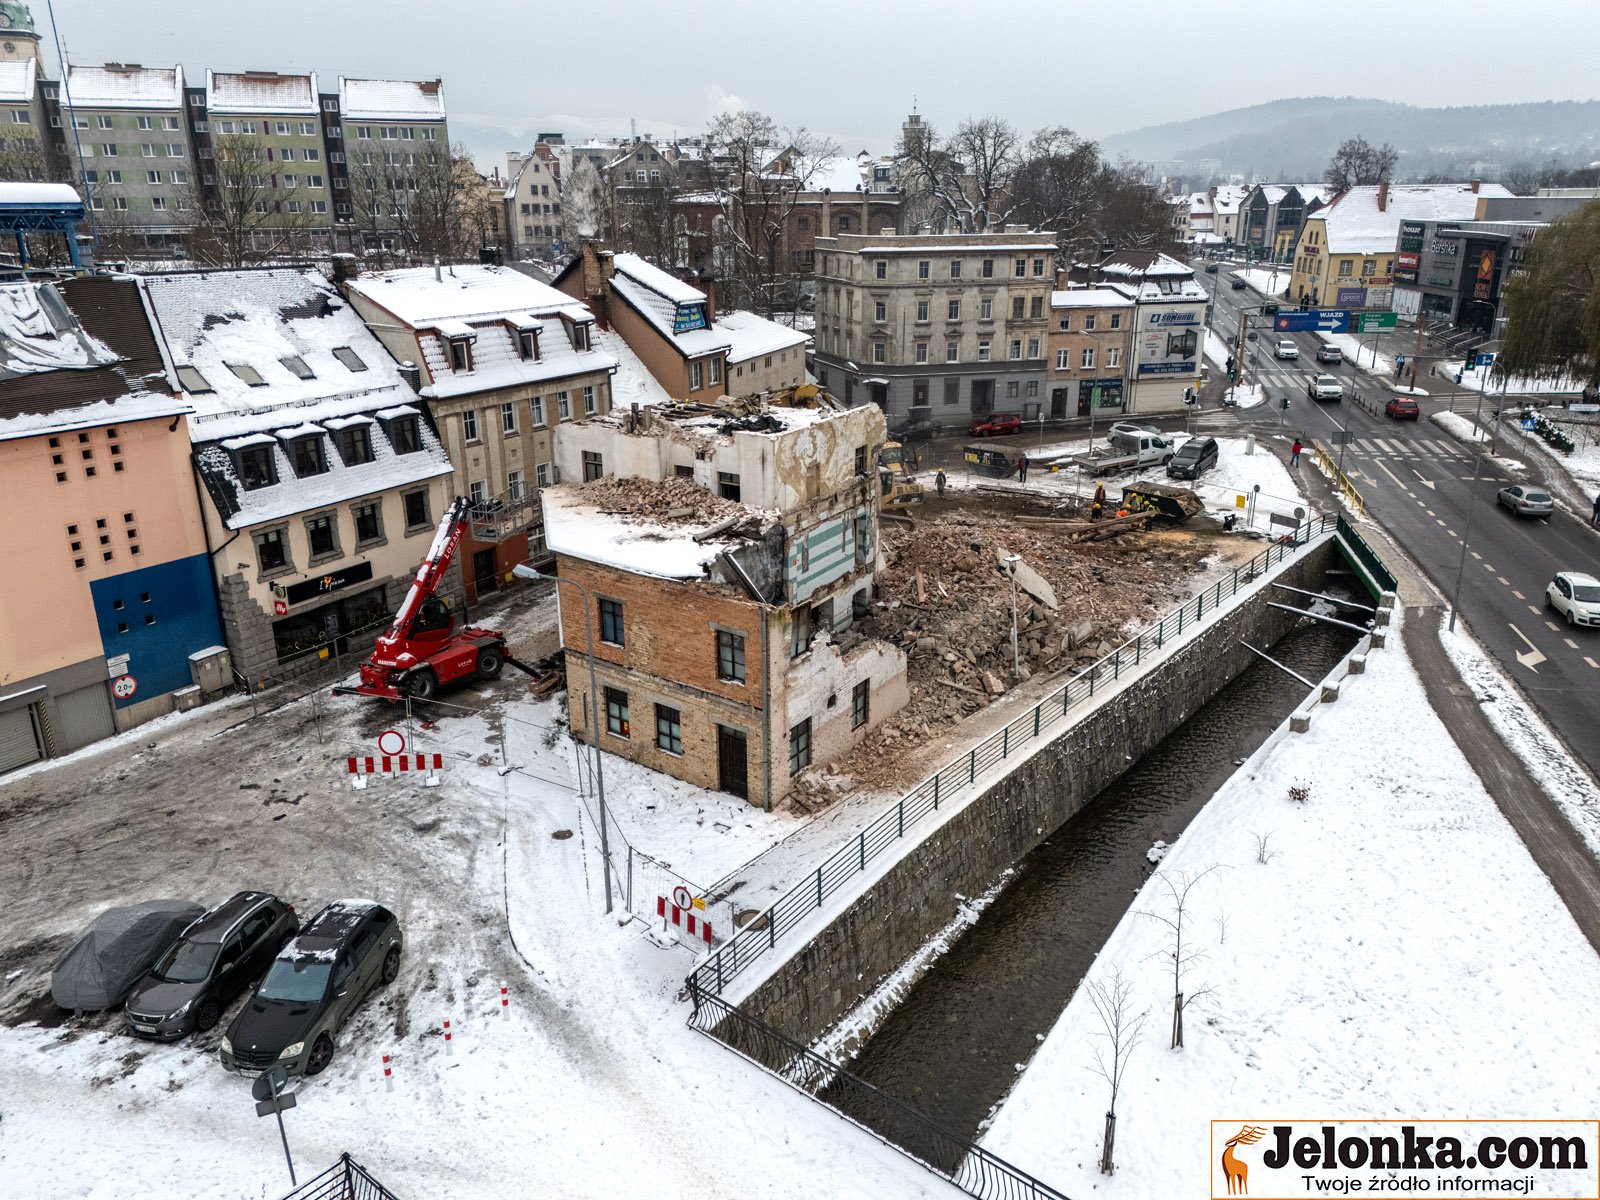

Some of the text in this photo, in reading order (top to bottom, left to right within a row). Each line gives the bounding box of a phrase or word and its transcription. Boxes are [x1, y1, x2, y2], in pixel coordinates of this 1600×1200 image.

[1403, 225, 1422, 234] house
[1431, 240, 1456, 254] Bershka
[444, 528, 461, 559] LORAN
[276, 604, 286, 613] illy
